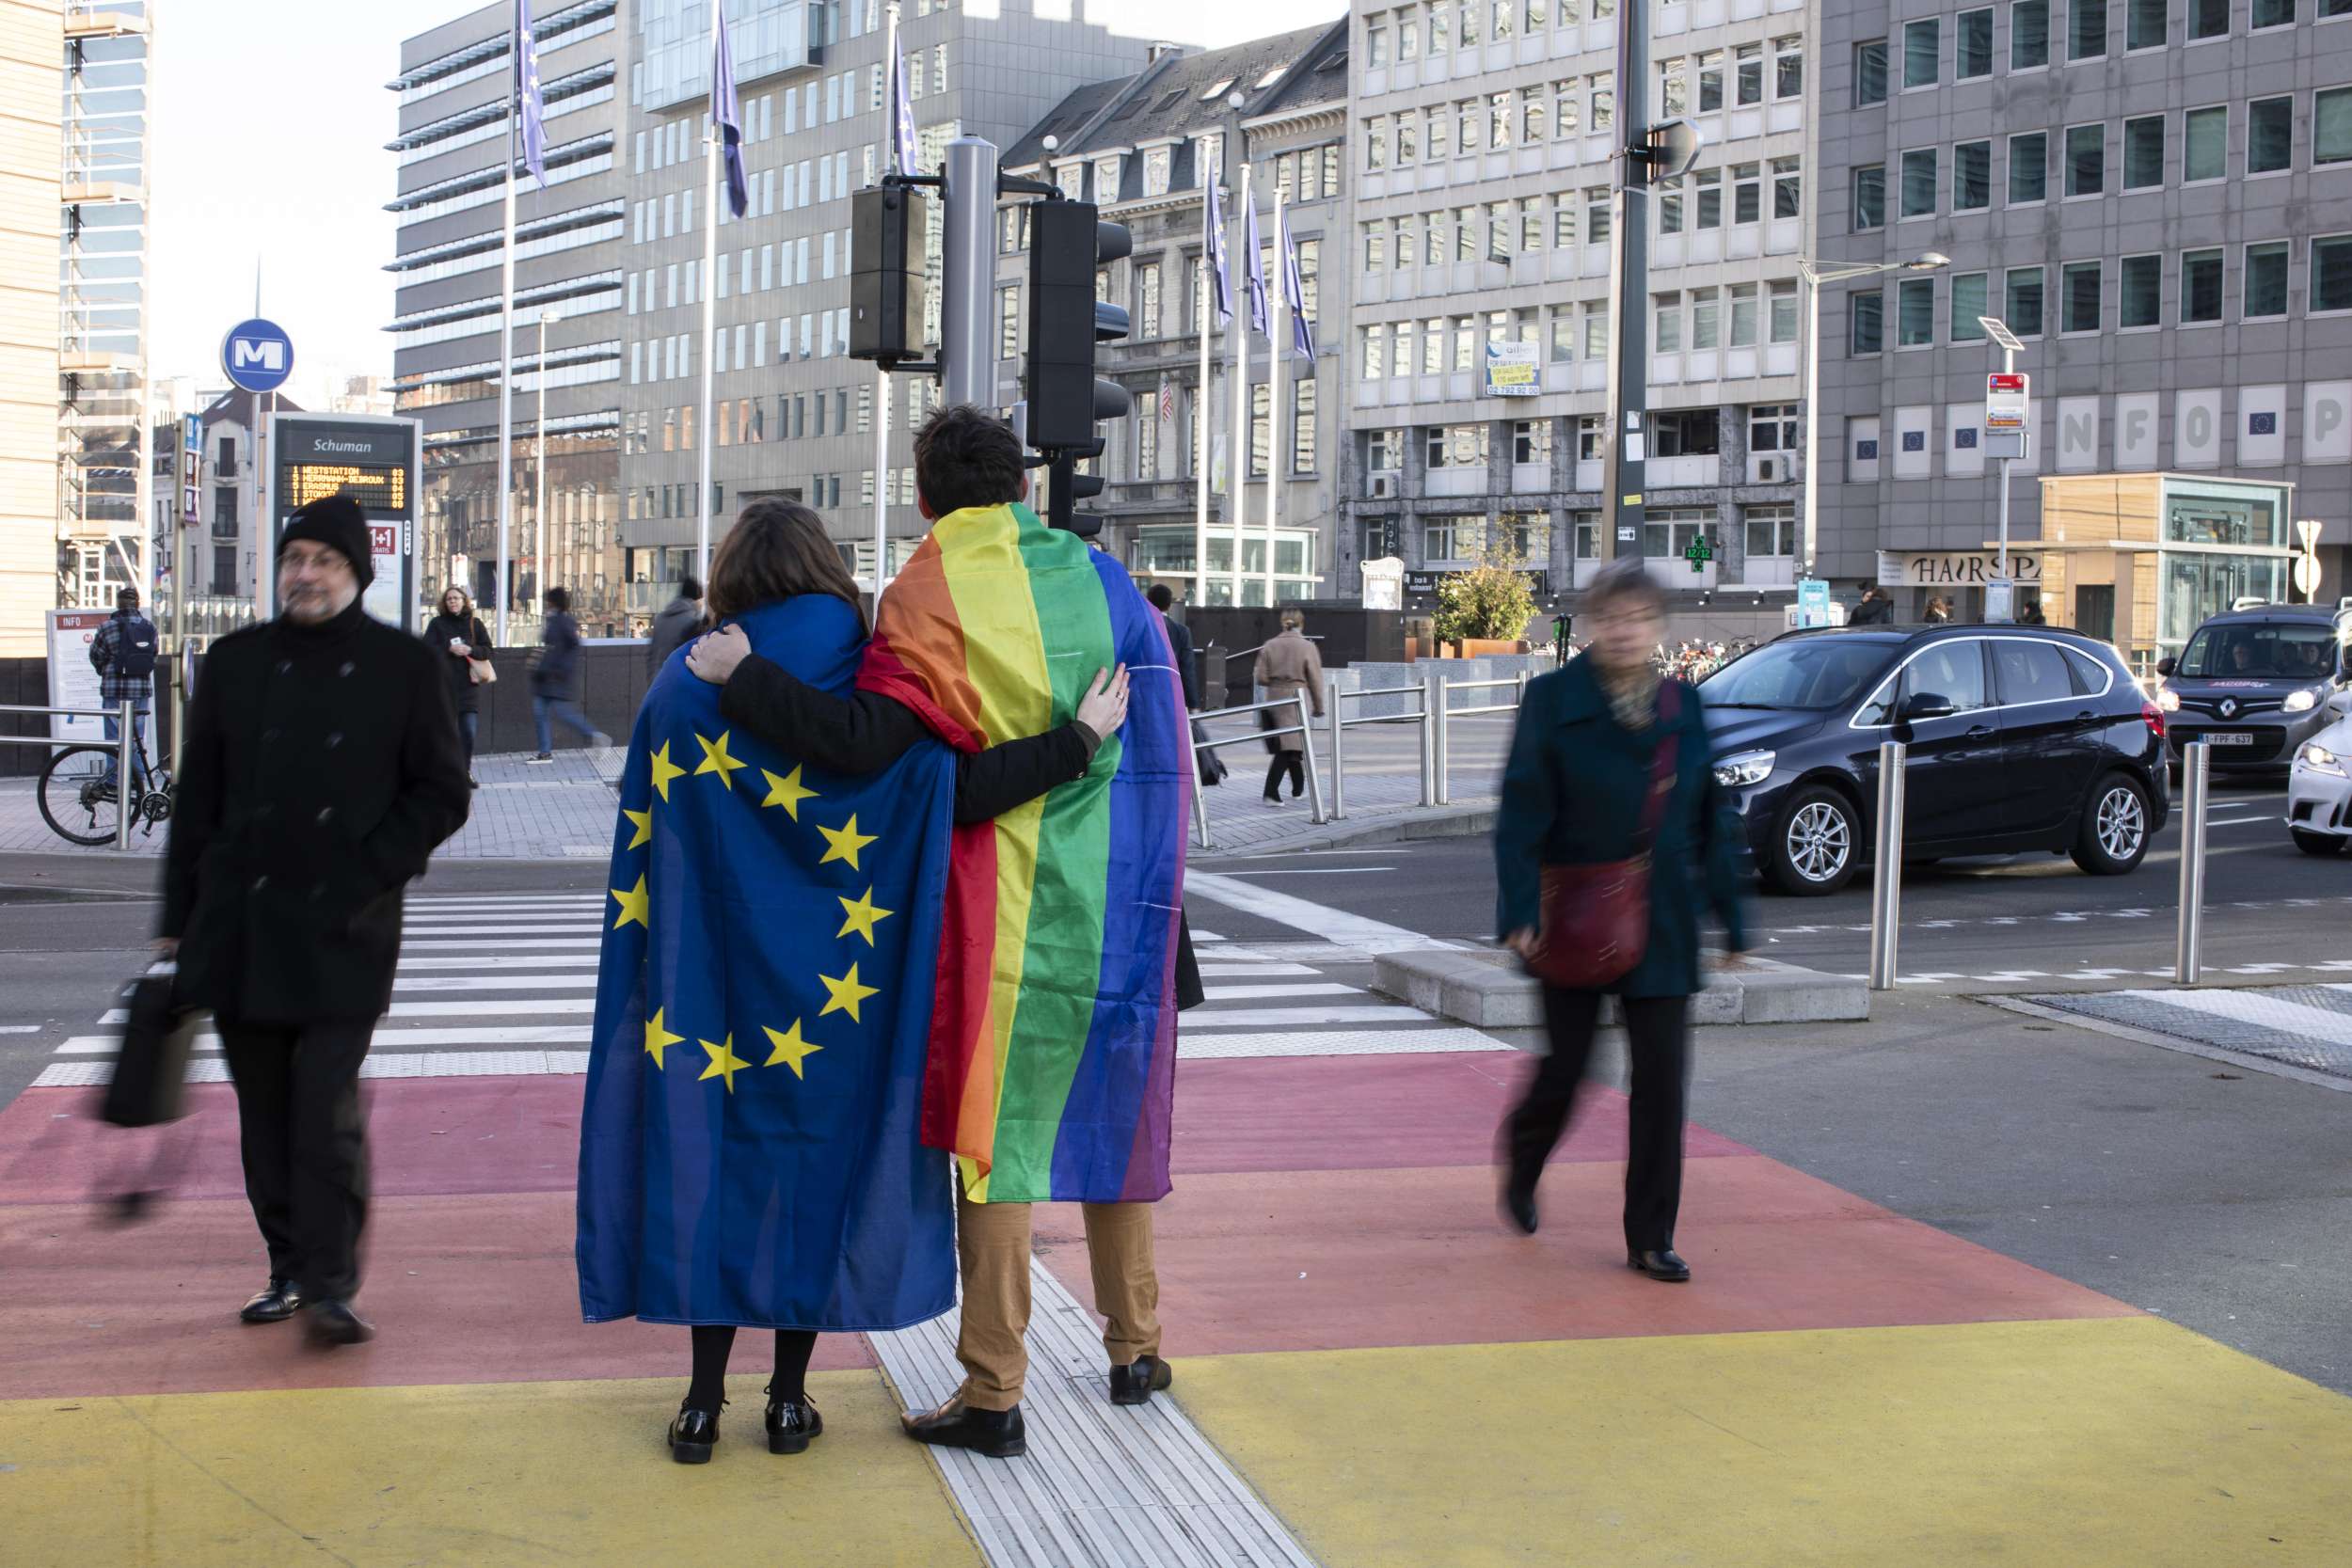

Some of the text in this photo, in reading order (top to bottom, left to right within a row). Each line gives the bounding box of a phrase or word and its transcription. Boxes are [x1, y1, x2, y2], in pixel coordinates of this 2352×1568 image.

[235, 340, 283, 370] M
[313, 438, 372, 452] Schuman
[302, 466, 359, 476] WESTSTATION
[391, 468, 405, 477] 03
[302, 483, 340, 491] ERASMUS
[1687, 548, 1710, 558] 12/12
[1912, 557, 2042, 582] HAIRSP
[63, 617, 81, 626] INFO
